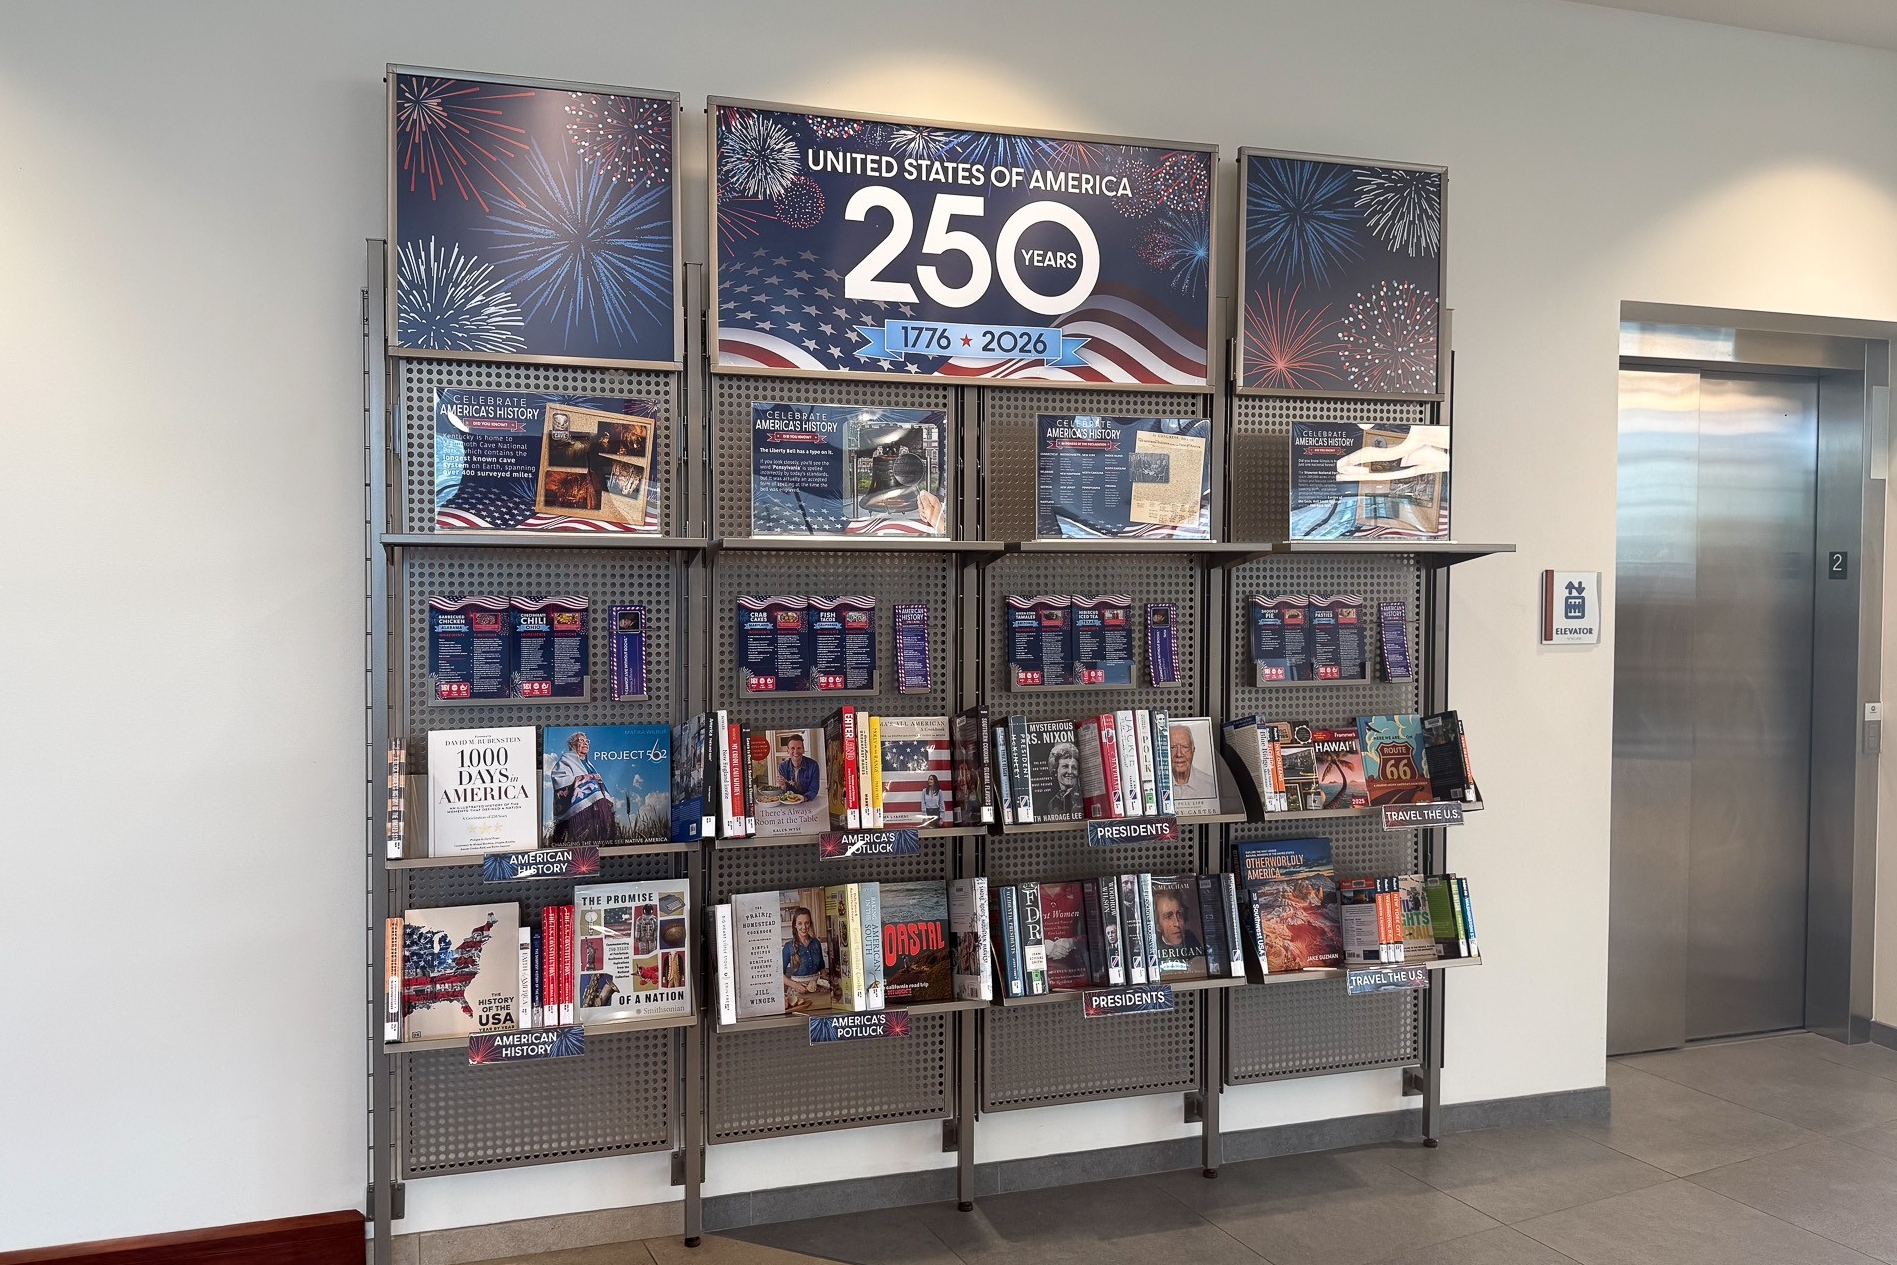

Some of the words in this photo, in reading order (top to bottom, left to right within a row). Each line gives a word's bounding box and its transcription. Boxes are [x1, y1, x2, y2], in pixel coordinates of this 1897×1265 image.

[808, 149, 898, 178] UNITED
[903, 160, 985, 186] STATES
[990, 166, 1024, 188] OF
[1029, 170, 1133, 198] AMERICA
[844, 185, 1100, 315] 250
[1021, 249, 1077, 269] YEARS
[901, 325, 951, 350] 1776
[981, 330, 1047, 354] 2026
[453, 394, 526, 407] CELEBRATE
[440, 404, 494, 418] AMERICA'S
[497, 406, 539, 419] HISTORY
[767, 411, 827, 421] CELEBRATE
[756, 419, 801, 431] AMERICA'S
[802, 421, 838, 433] HISTORY
[1057, 419, 1112, 429] CELEBRATE
[443, 433, 474, 441] Kentucky
[1047, 428, 1088, 439] AMERICA'S
[1089, 429, 1121, 440] HISTORY
[498, 442, 528, 450] National
[1295, 437, 1327, 446] AMERICA'S
[1328, 438, 1354, 446] HISTORY
[482, 463, 503, 471] Earth,
[477, 470, 511, 478] surveyed
[1832, 554, 1842, 571] 2
[1555, 627, 1593, 635] ELEVATOR
[1029, 722, 1073, 732] MYSTERIOUS
[477, 736, 521, 745] RUBENSTEIN
[1043, 731, 1075, 744] NIXON
[1124, 716, 1135, 767] JACKIE
[594, 750, 644, 761] PROJECT
[647, 739, 667, 764] 562
[1020, 734, 1029, 778] PRESIDENT
[1142, 736, 1151, 773] POLK
[1383, 746, 1407, 754] ROUTE
[457, 746, 509, 769] 1,000
[1386, 759, 1411, 780] 66
[458, 768, 509, 786] DAYS
[510, 773, 520, 783] in
[438, 784, 529, 804] AMERICA
[760, 807, 786, 818] There's
[787, 805, 812, 817] Always
[1072, 812, 1082, 820] LEE
[1386, 811, 1422, 821] TRAVEL
[1423, 810, 1442, 819] THE
[1443, 809, 1460, 819] U.S.
[755, 816, 776, 826] Room
[777, 817, 785, 825] at
[786, 815, 798, 824] the
[799, 814, 818, 823] Table
[1097, 823, 1170, 838] PRESIDENTS
[551, 840, 581, 848] CHANGING
[841, 833, 895, 844] AMERICA'S
[510, 851, 572, 864] AMERICAN
[1245, 854, 1304, 869] OTHERWORLDLY
[1247, 868, 1281, 880] AMERICA
[582, 896, 602, 906] THE
[606, 892, 653, 904] PROMISE
[865, 899, 871, 907] IN
[1102, 886, 1110, 913] WILSON
[1108, 881, 1117, 916] WOODROW
[745, 912, 772, 921] PRAIRIE
[1022, 889, 1041, 940] FDR
[1052, 909, 1080, 919] Women
[742, 920, 776, 928] HOMESTEAD
[1252, 904, 1262, 939] Southwest
[1257, 940, 1265, 954] USA
[872, 924, 881, 972] AMERICAN
[882, 921, 945, 967] OASTAL
[1351, 974, 1387, 986] TRAVEL
[1388, 972, 1407, 980] THE
[1409, 970, 1425, 980] U.S.
[478, 997, 514, 1005] HISTORY
[619, 996, 633, 1005] OF
[635, 995, 641, 1004] A
[645, 991, 684, 1003] NATION
[750, 997, 776, 1005] WINGER
[1092, 991, 1165, 1008] PRESIDENTS
[643, 1005, 685, 1015] Smithsonian
[479, 1012, 514, 1026] USA
[831, 1014, 886, 1027] AMERICA'S
[838, 1025, 884, 1038] POTLUCK
[494, 1032, 557, 1046] AMERICAN
[502, 1044, 552, 1058] HISTORY
